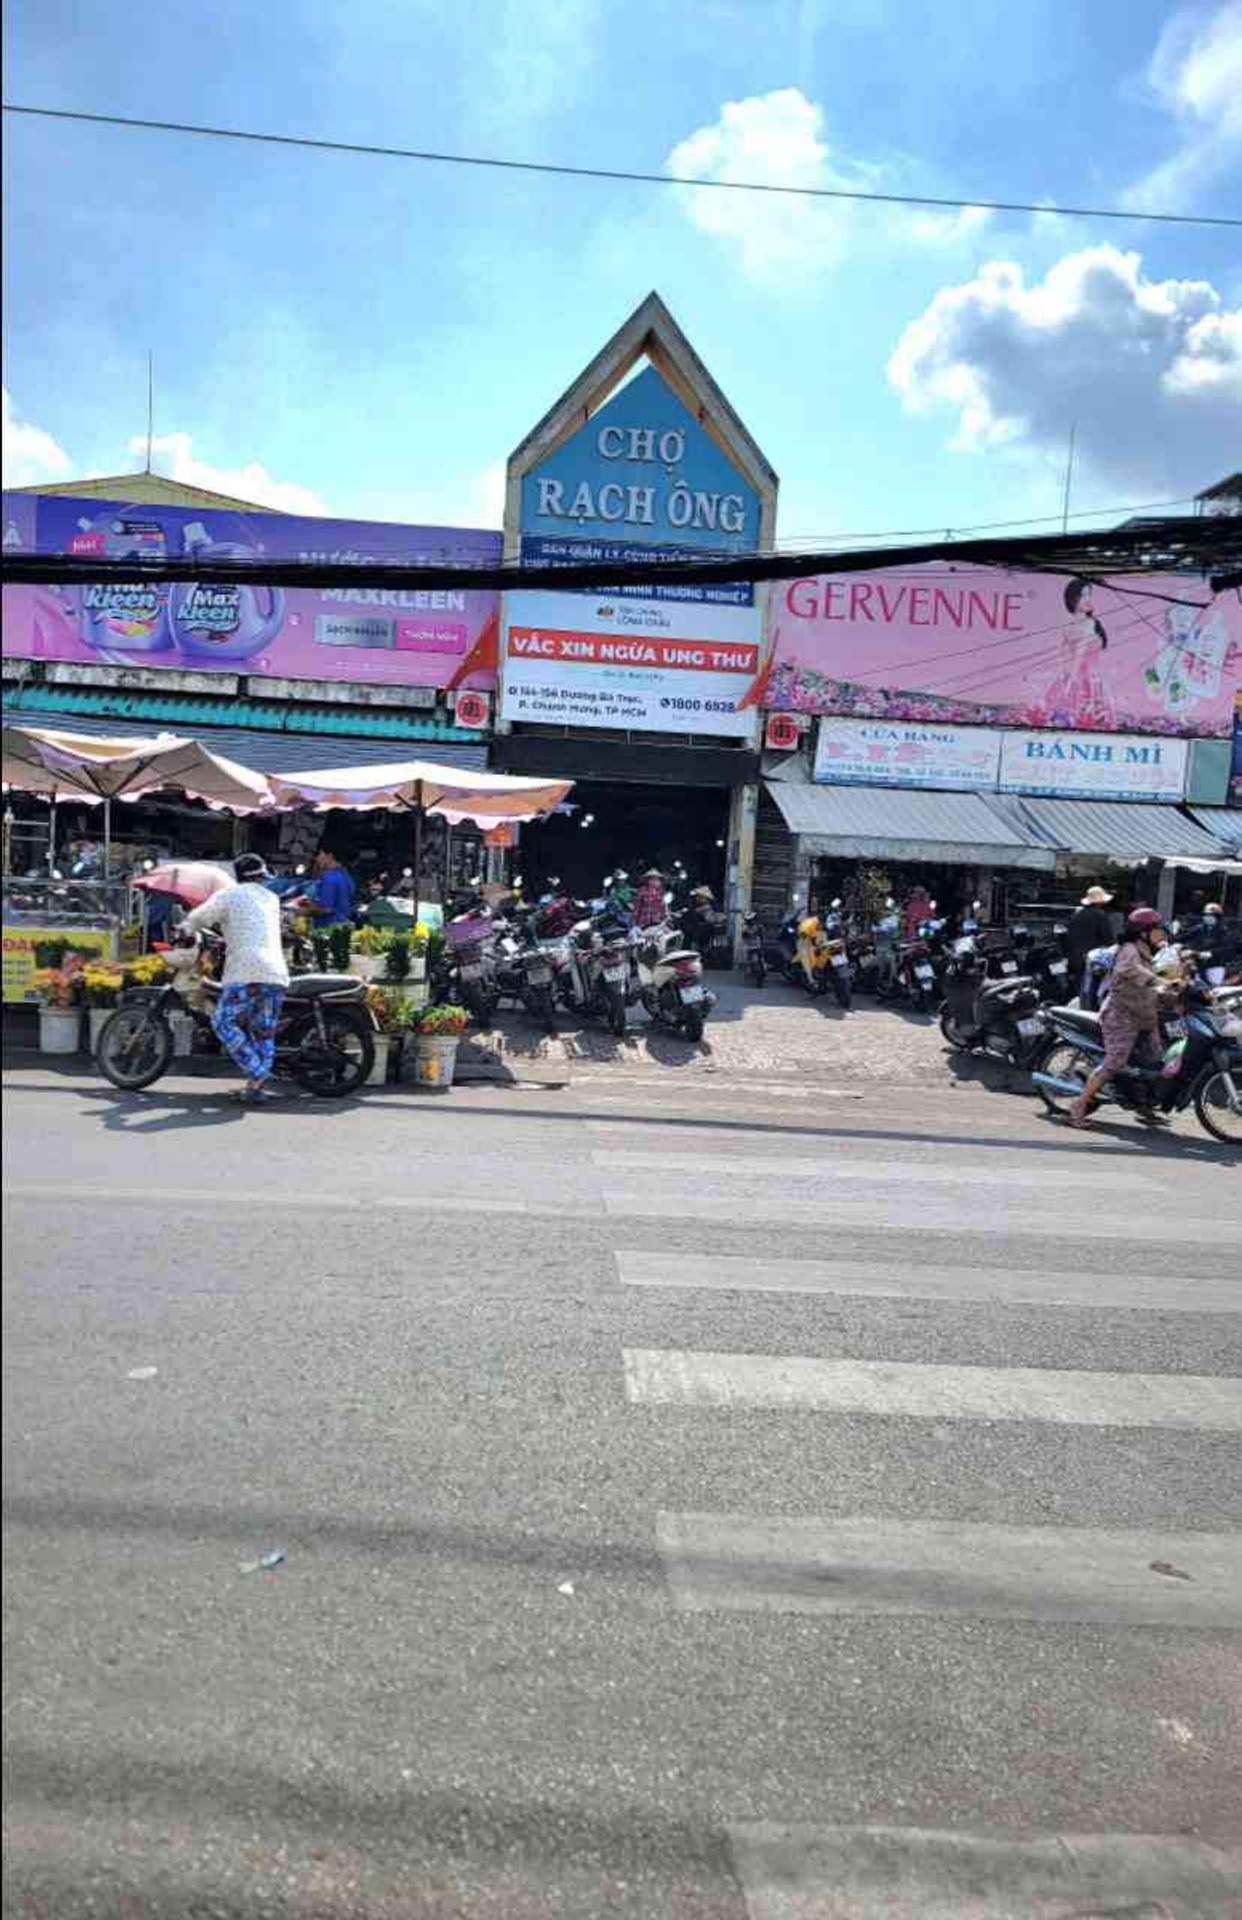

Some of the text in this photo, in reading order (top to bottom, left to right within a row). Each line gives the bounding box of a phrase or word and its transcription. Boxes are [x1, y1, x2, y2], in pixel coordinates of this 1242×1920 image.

[598, 426, 685, 472] CHỢ
[536, 478, 745, 532] RẠCH ÔNG
[192, 587, 241, 605] Max
[321, 588, 465, 611] MAXKLEEN
[786, 579, 1024, 630] GERVENNE
[560, 641, 595, 657] XIN
[663, 647, 705, 666] UNG
[711, 651, 752, 669] THƯ
[671, 698, 701, 711] 1800
[1024, 738, 1113, 762] BÁNH
